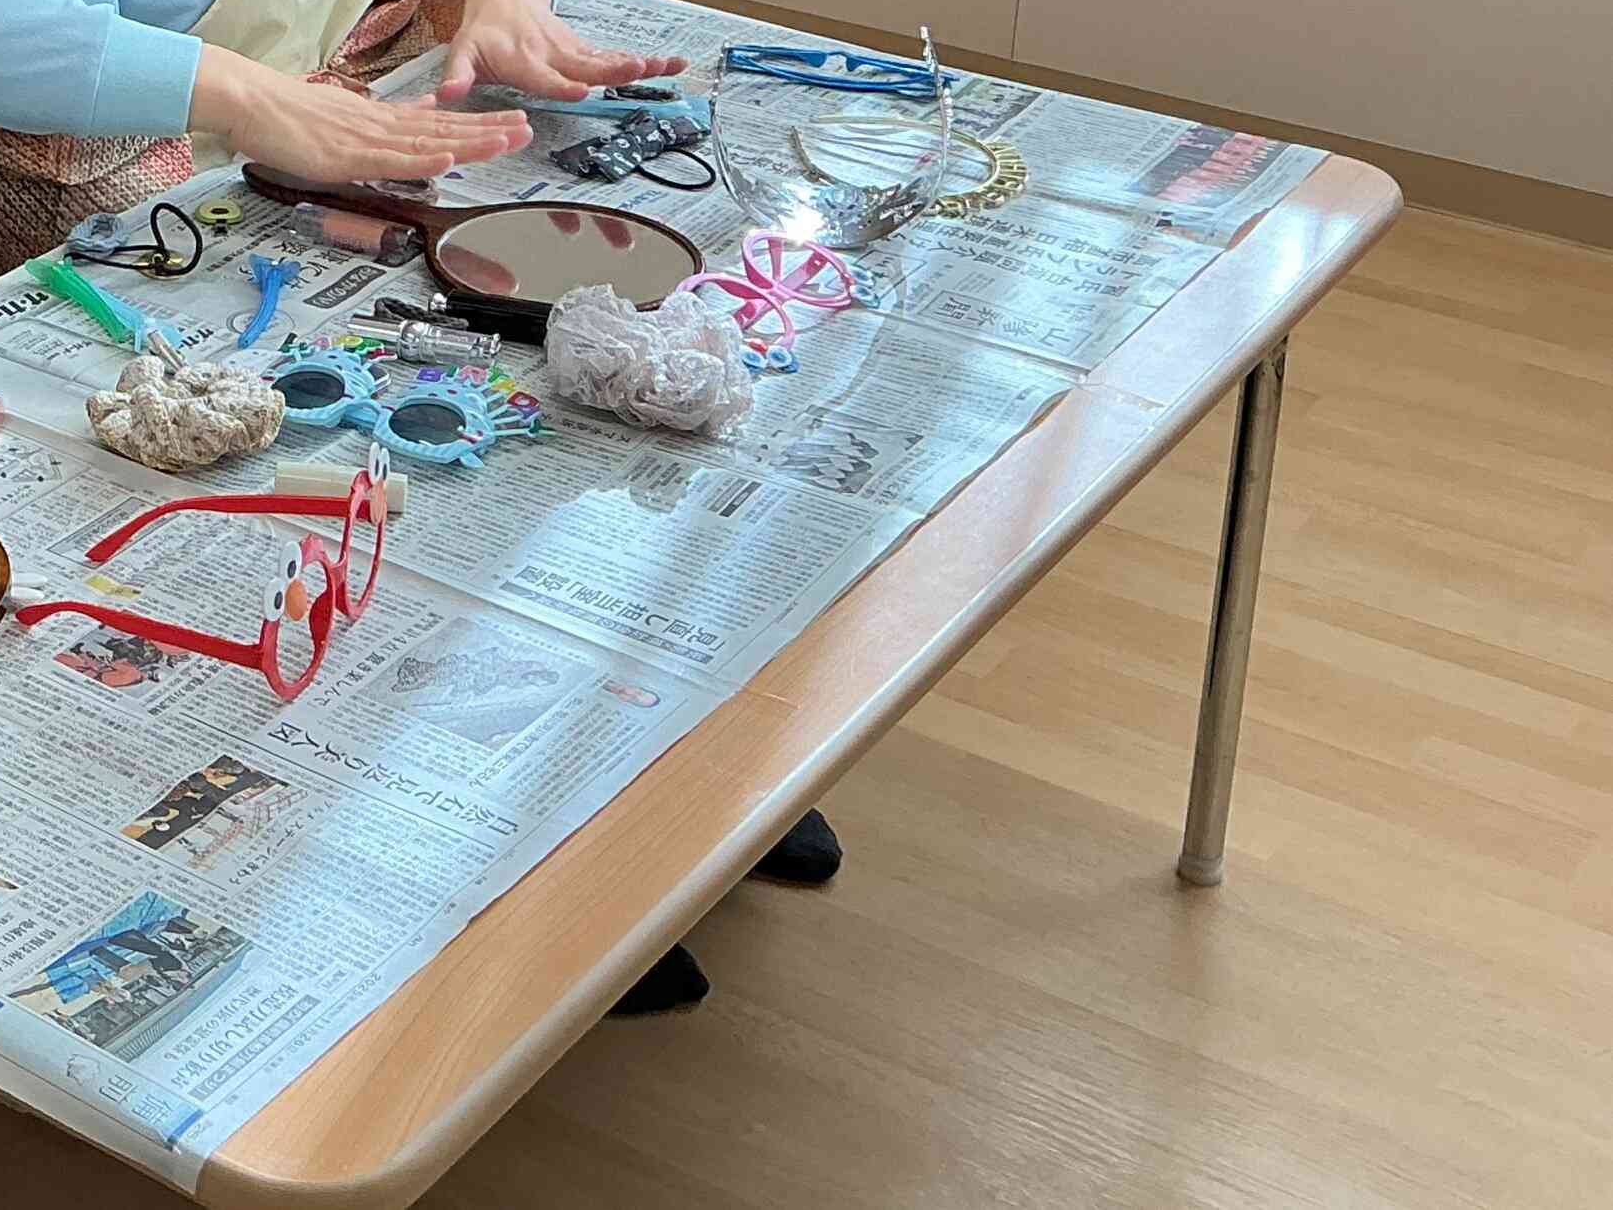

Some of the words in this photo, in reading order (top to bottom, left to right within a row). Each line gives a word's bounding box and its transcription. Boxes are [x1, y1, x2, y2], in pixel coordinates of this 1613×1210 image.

[938, 295, 1071, 347] 山陽新聞
[98, 1072, 173, 1125] 備前
